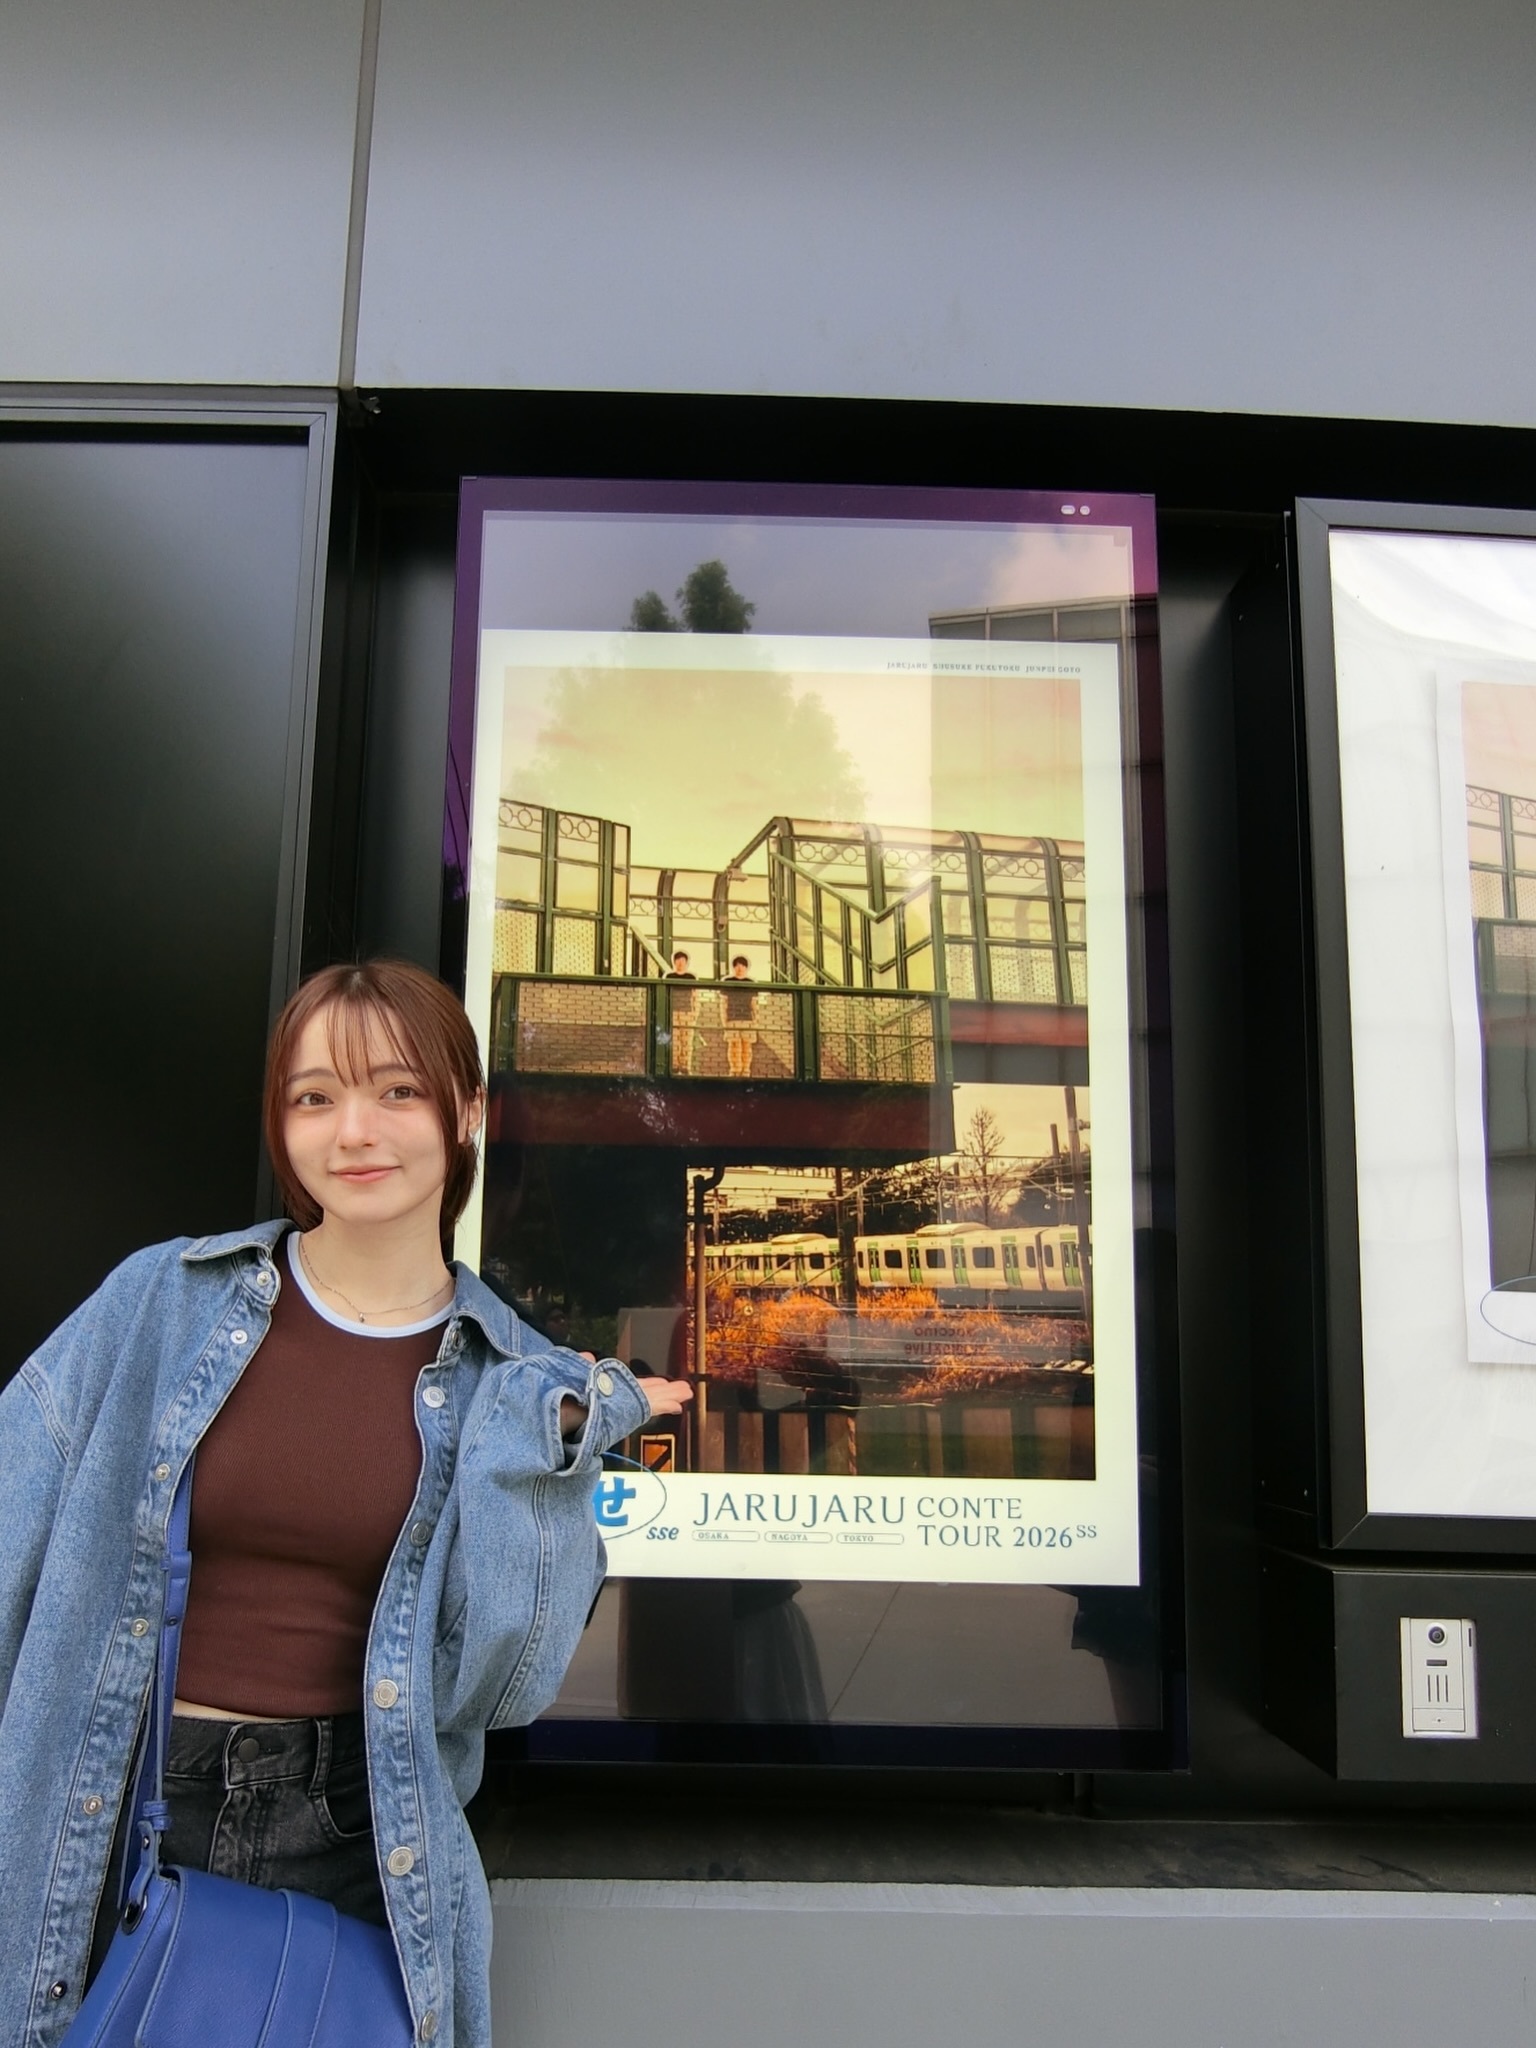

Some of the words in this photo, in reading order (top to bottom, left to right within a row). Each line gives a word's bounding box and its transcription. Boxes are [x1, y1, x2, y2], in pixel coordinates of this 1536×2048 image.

[693, 1492, 905, 1529] JARUJARU
[917, 1496, 1023, 1519] CONTE
[646, 1525, 680, 1541] sse
[698, 1531, 730, 1540] OSAKA
[771, 1533, 809, 1542] NAGOYA
[843, 1534, 875, 1543] TOKYO
[917, 1524, 1003, 1548] TOUR
